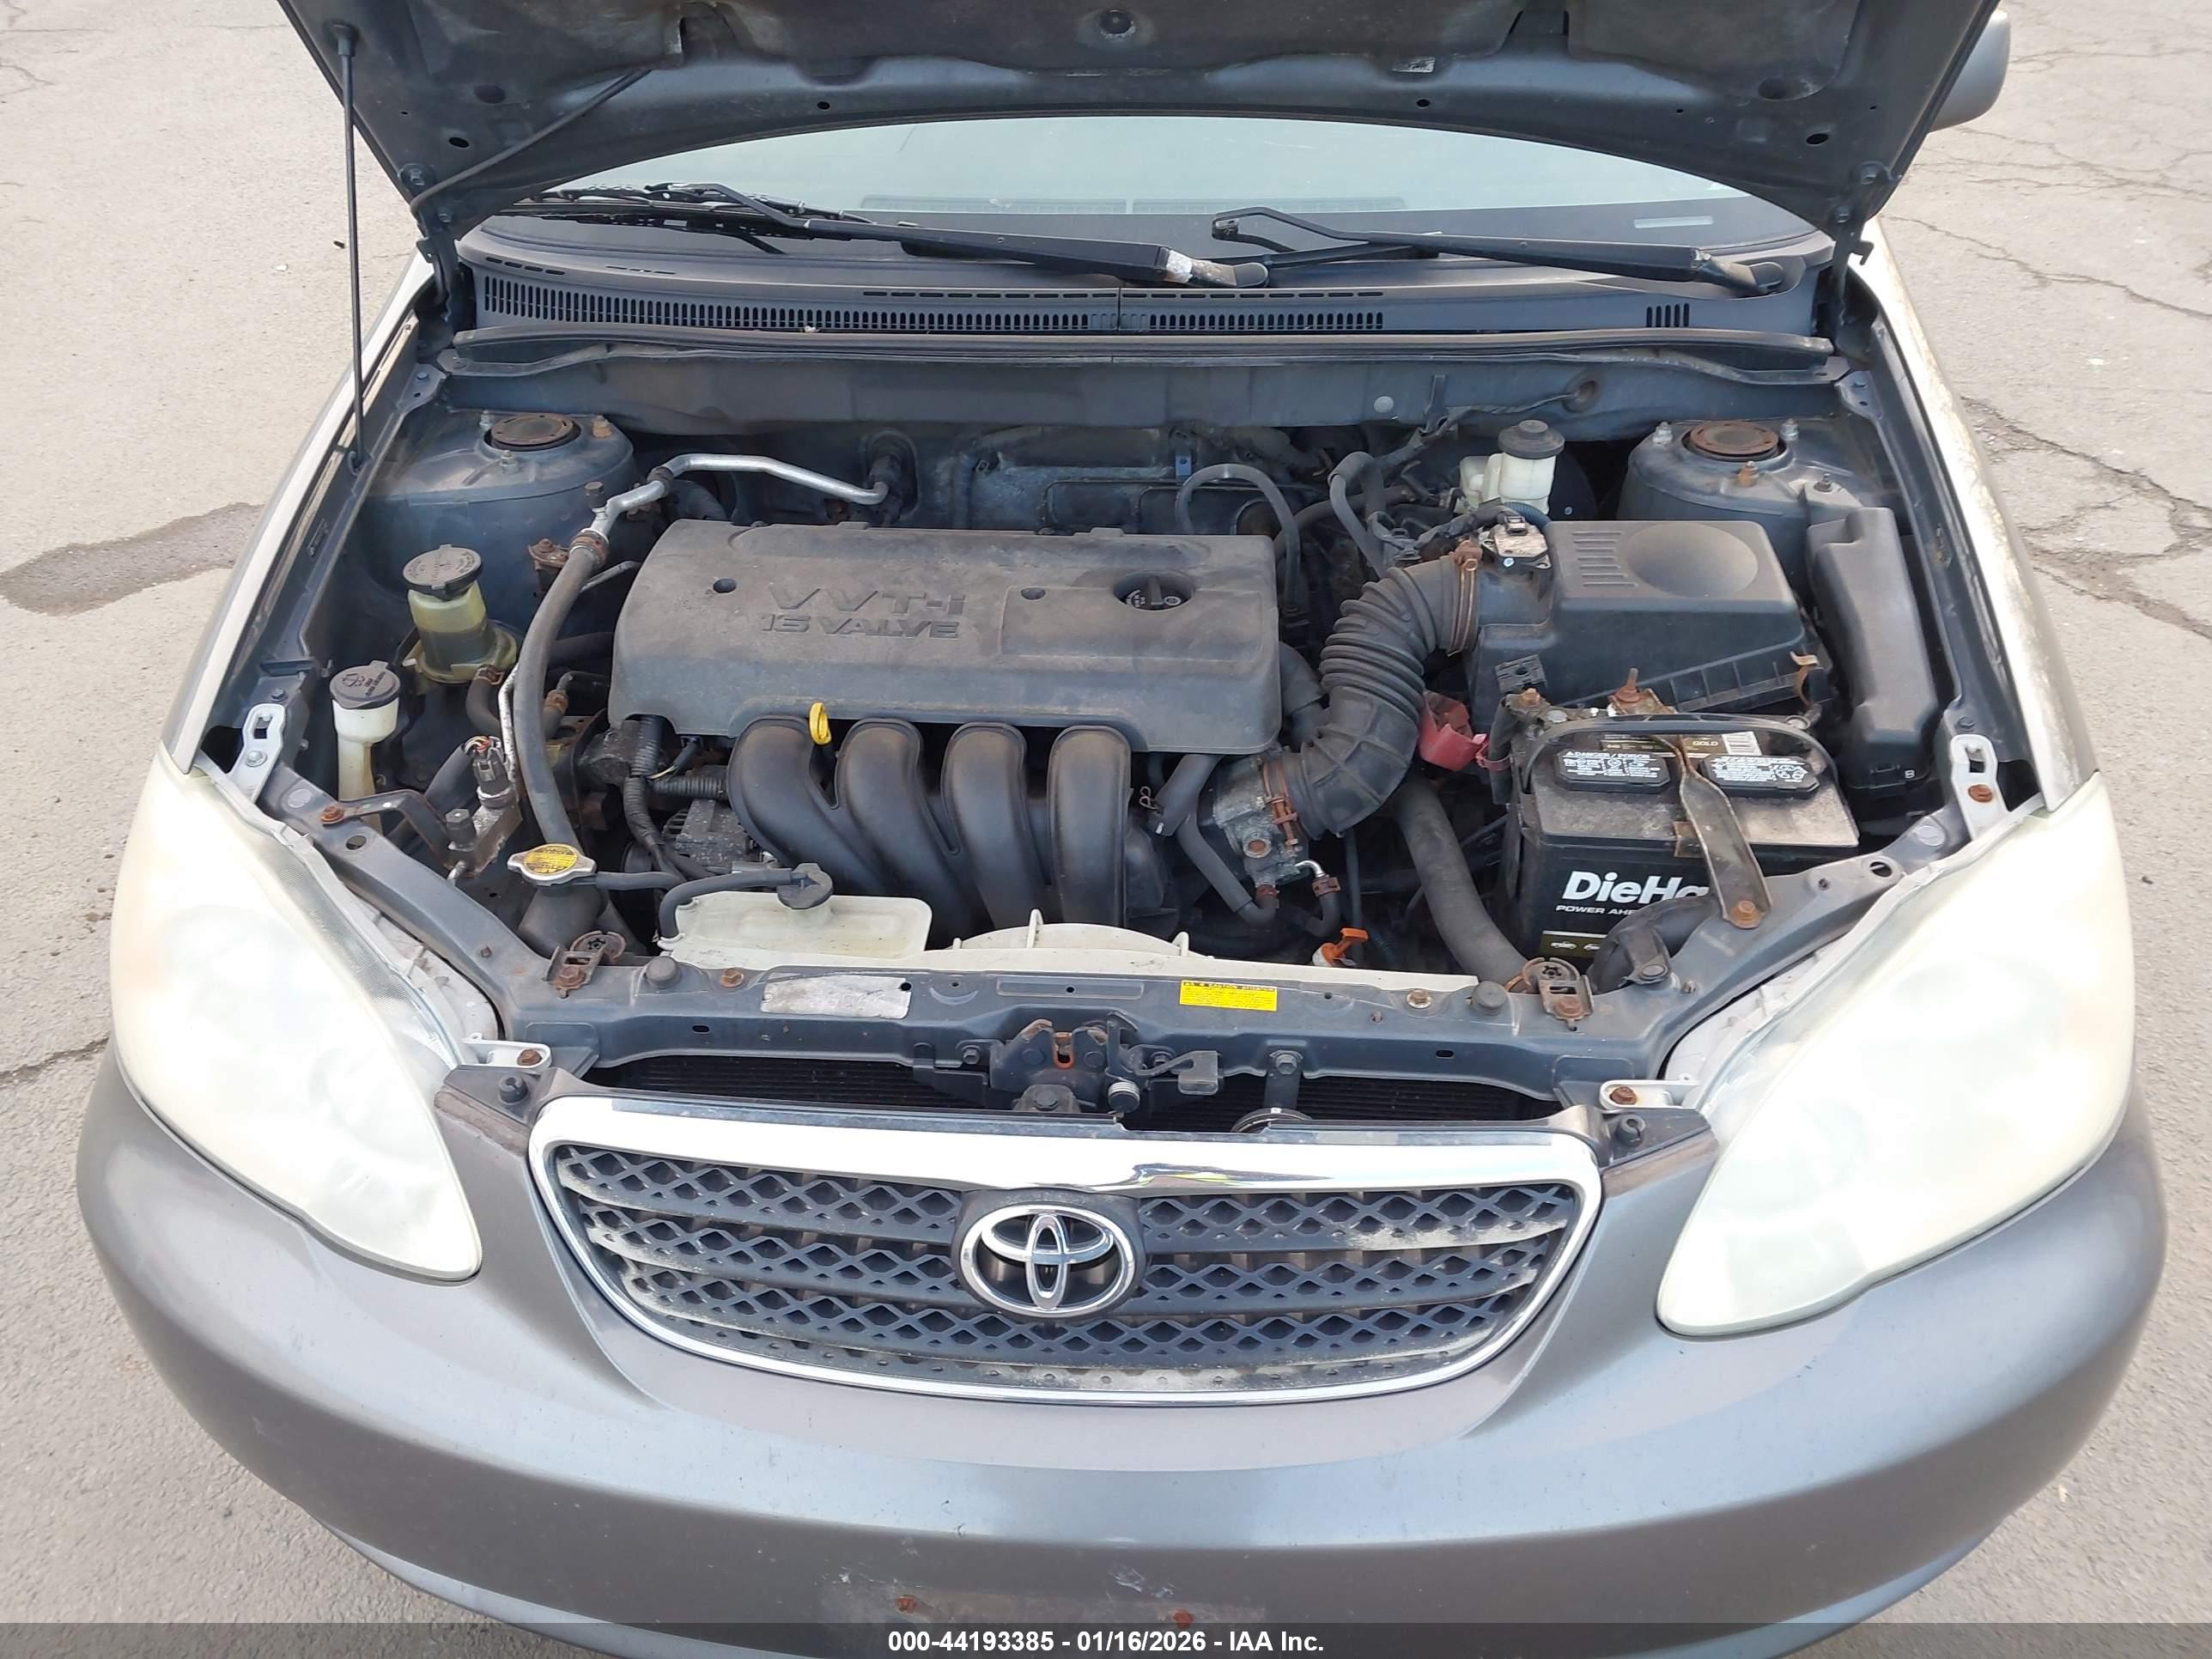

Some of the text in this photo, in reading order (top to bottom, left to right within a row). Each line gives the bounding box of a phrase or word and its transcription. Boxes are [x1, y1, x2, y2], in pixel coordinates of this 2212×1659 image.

[763, 614, 960, 639] 16 VALVE
[1905, 769, 1915, 779] B
[1555, 905, 1606, 915] POWER
